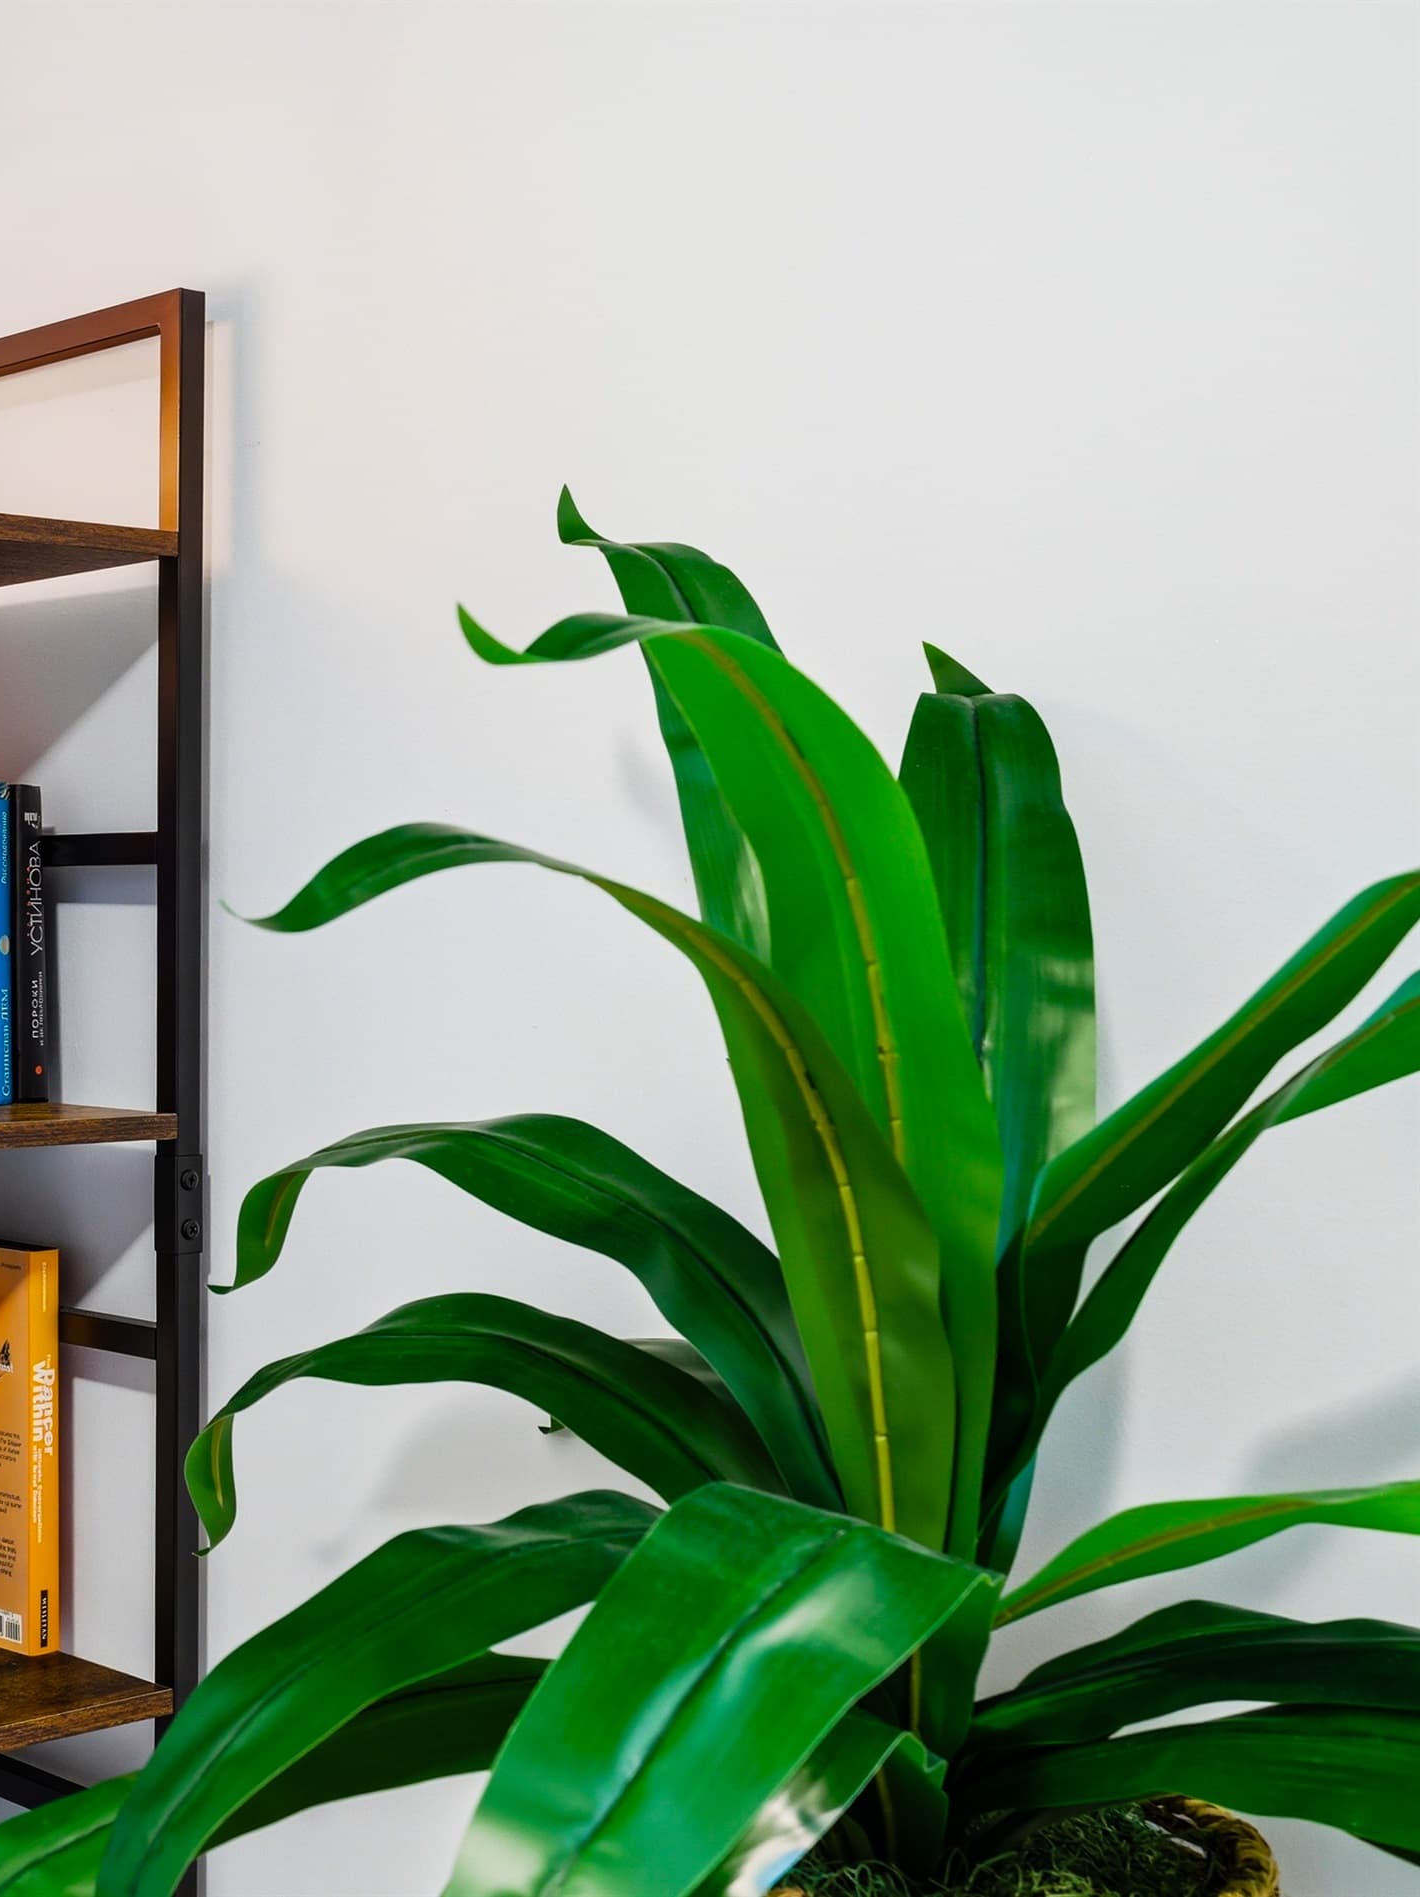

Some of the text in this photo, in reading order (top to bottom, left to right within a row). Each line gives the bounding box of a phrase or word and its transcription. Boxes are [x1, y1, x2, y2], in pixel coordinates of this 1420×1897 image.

[29, 840, 44, 956] УСТИНОВА
[31, 979, 39, 1039] ПОРОКИ
[32, 1360, 45, 1442] Within
